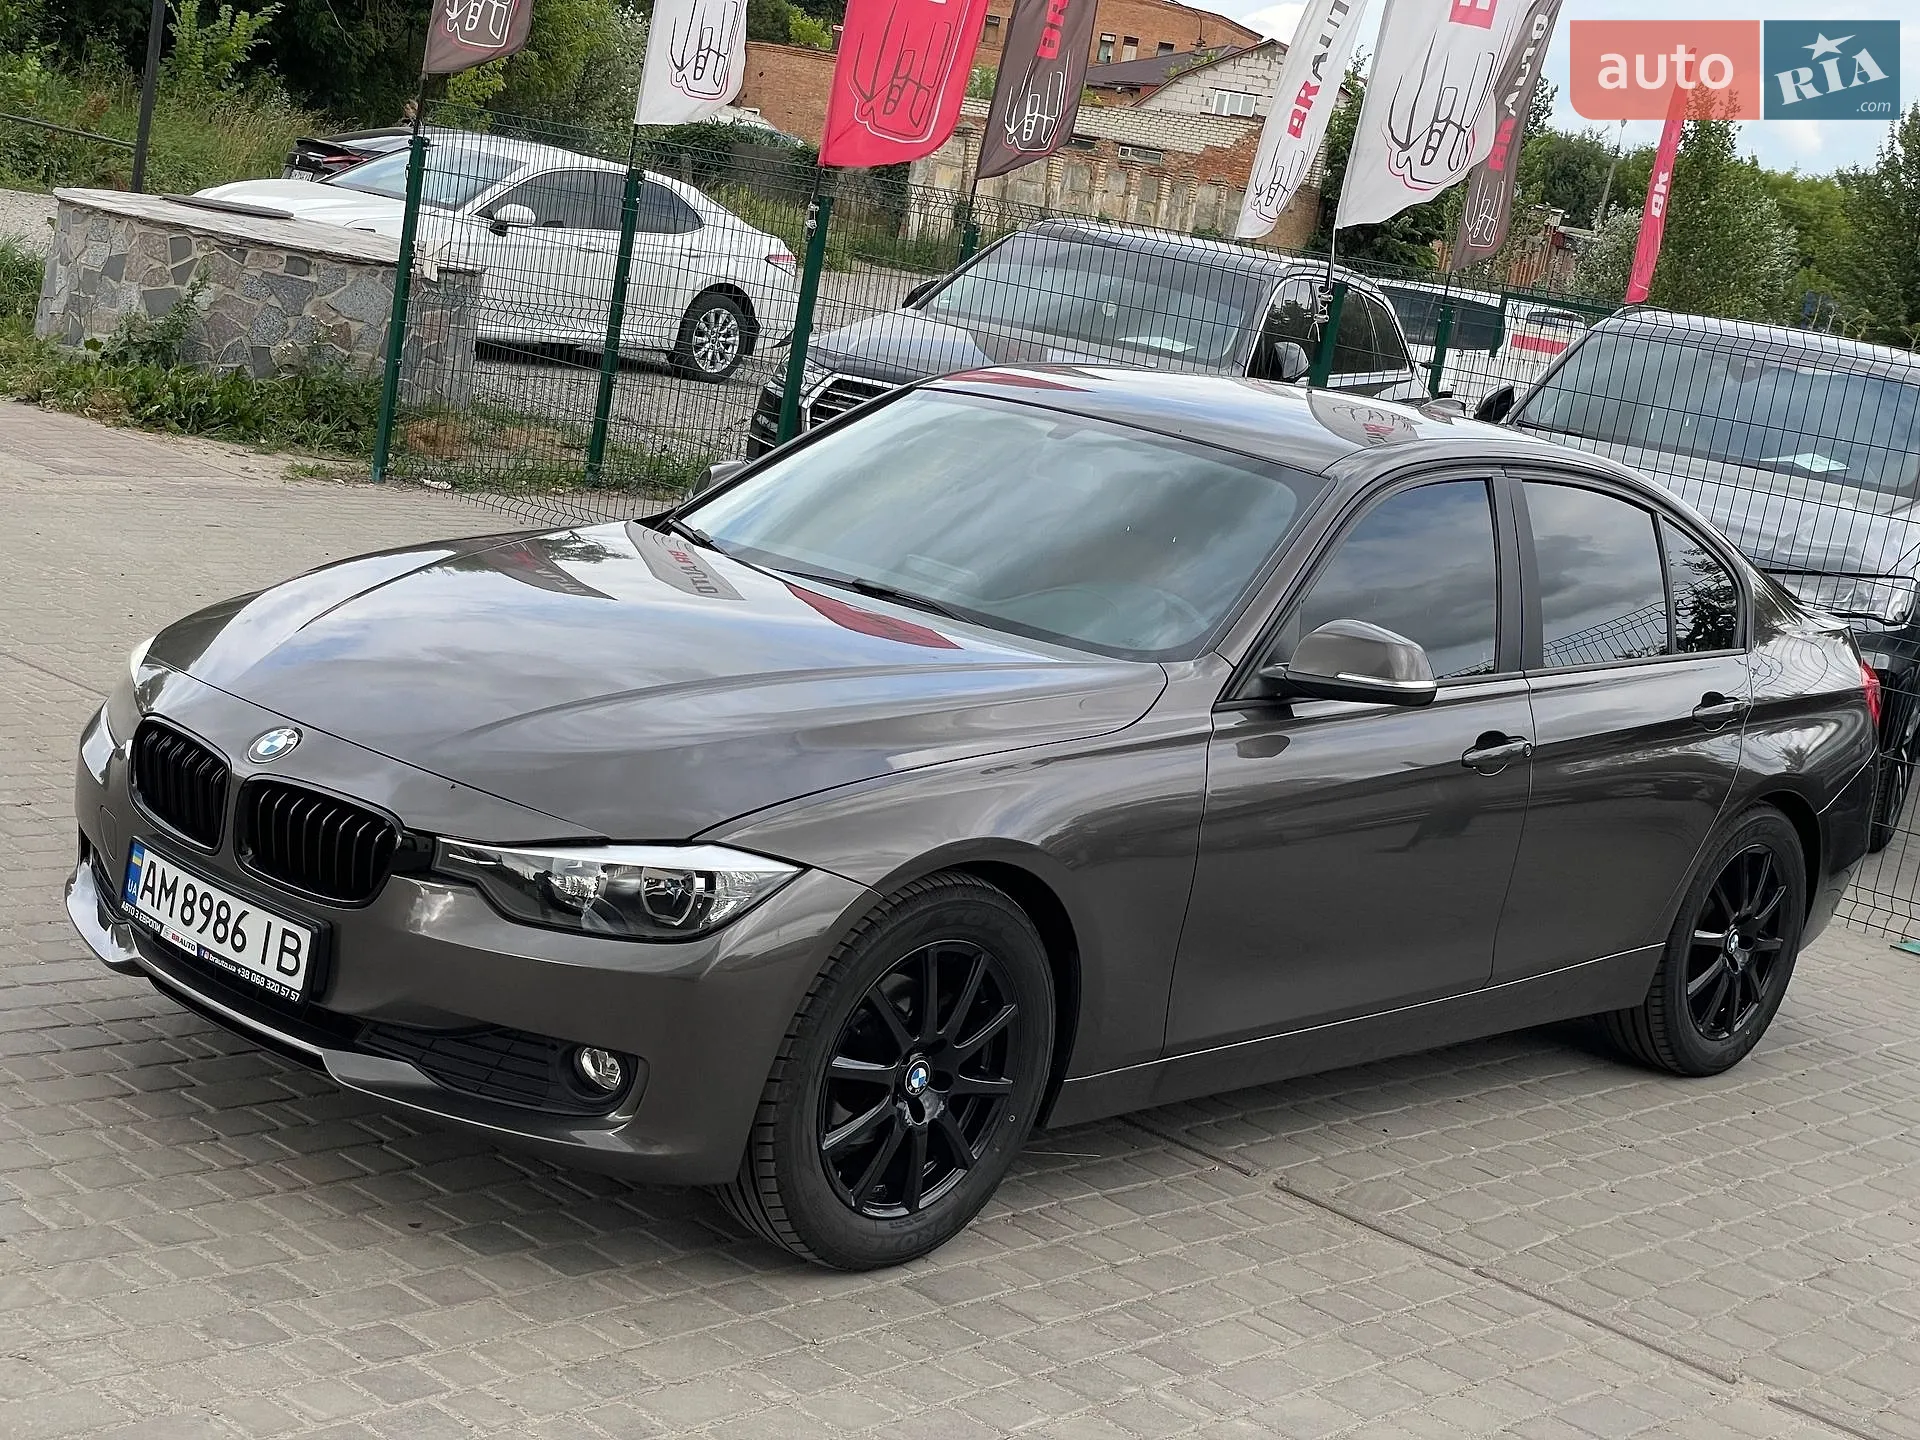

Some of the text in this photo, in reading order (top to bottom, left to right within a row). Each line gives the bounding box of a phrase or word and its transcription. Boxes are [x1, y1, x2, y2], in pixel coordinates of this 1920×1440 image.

[127, 879, 138, 897] UA
[261, 919, 302, 977] IB
[265, 979, 280, 993] 320
[280, 986, 290, 997] 57
[289, 991, 300, 1002] 57
